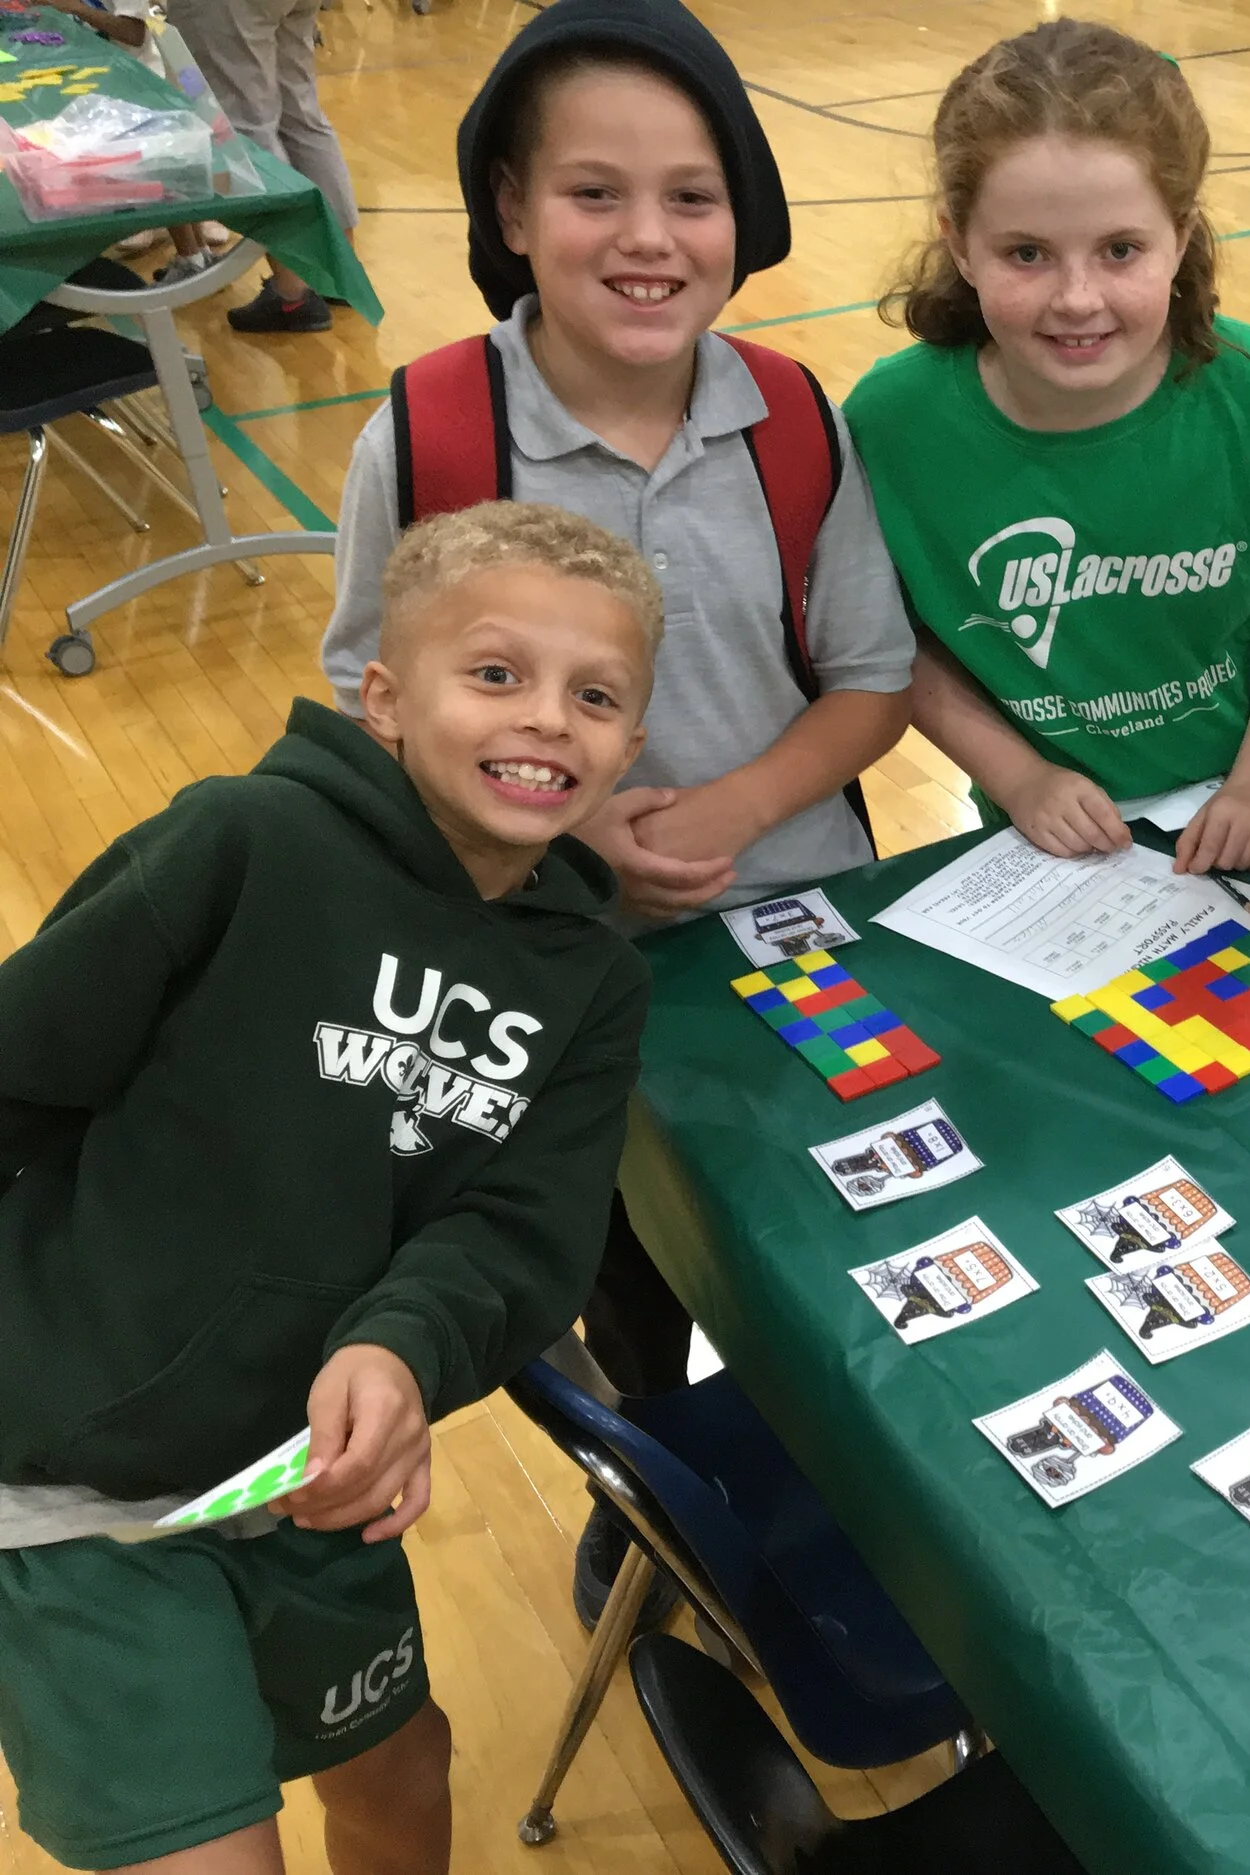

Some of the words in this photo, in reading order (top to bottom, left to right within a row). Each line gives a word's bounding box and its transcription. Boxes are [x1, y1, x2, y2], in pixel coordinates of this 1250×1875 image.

[1069, 681, 1183, 723] COMMUNITIES
[1133, 919, 1179, 955] PASSPORT
[1180, 905, 1216, 934] FAMILY
[1152, 934, 1179, 955] MATH
[373, 952, 543, 1081] UCS
[320, 1626, 414, 1724] UCS
